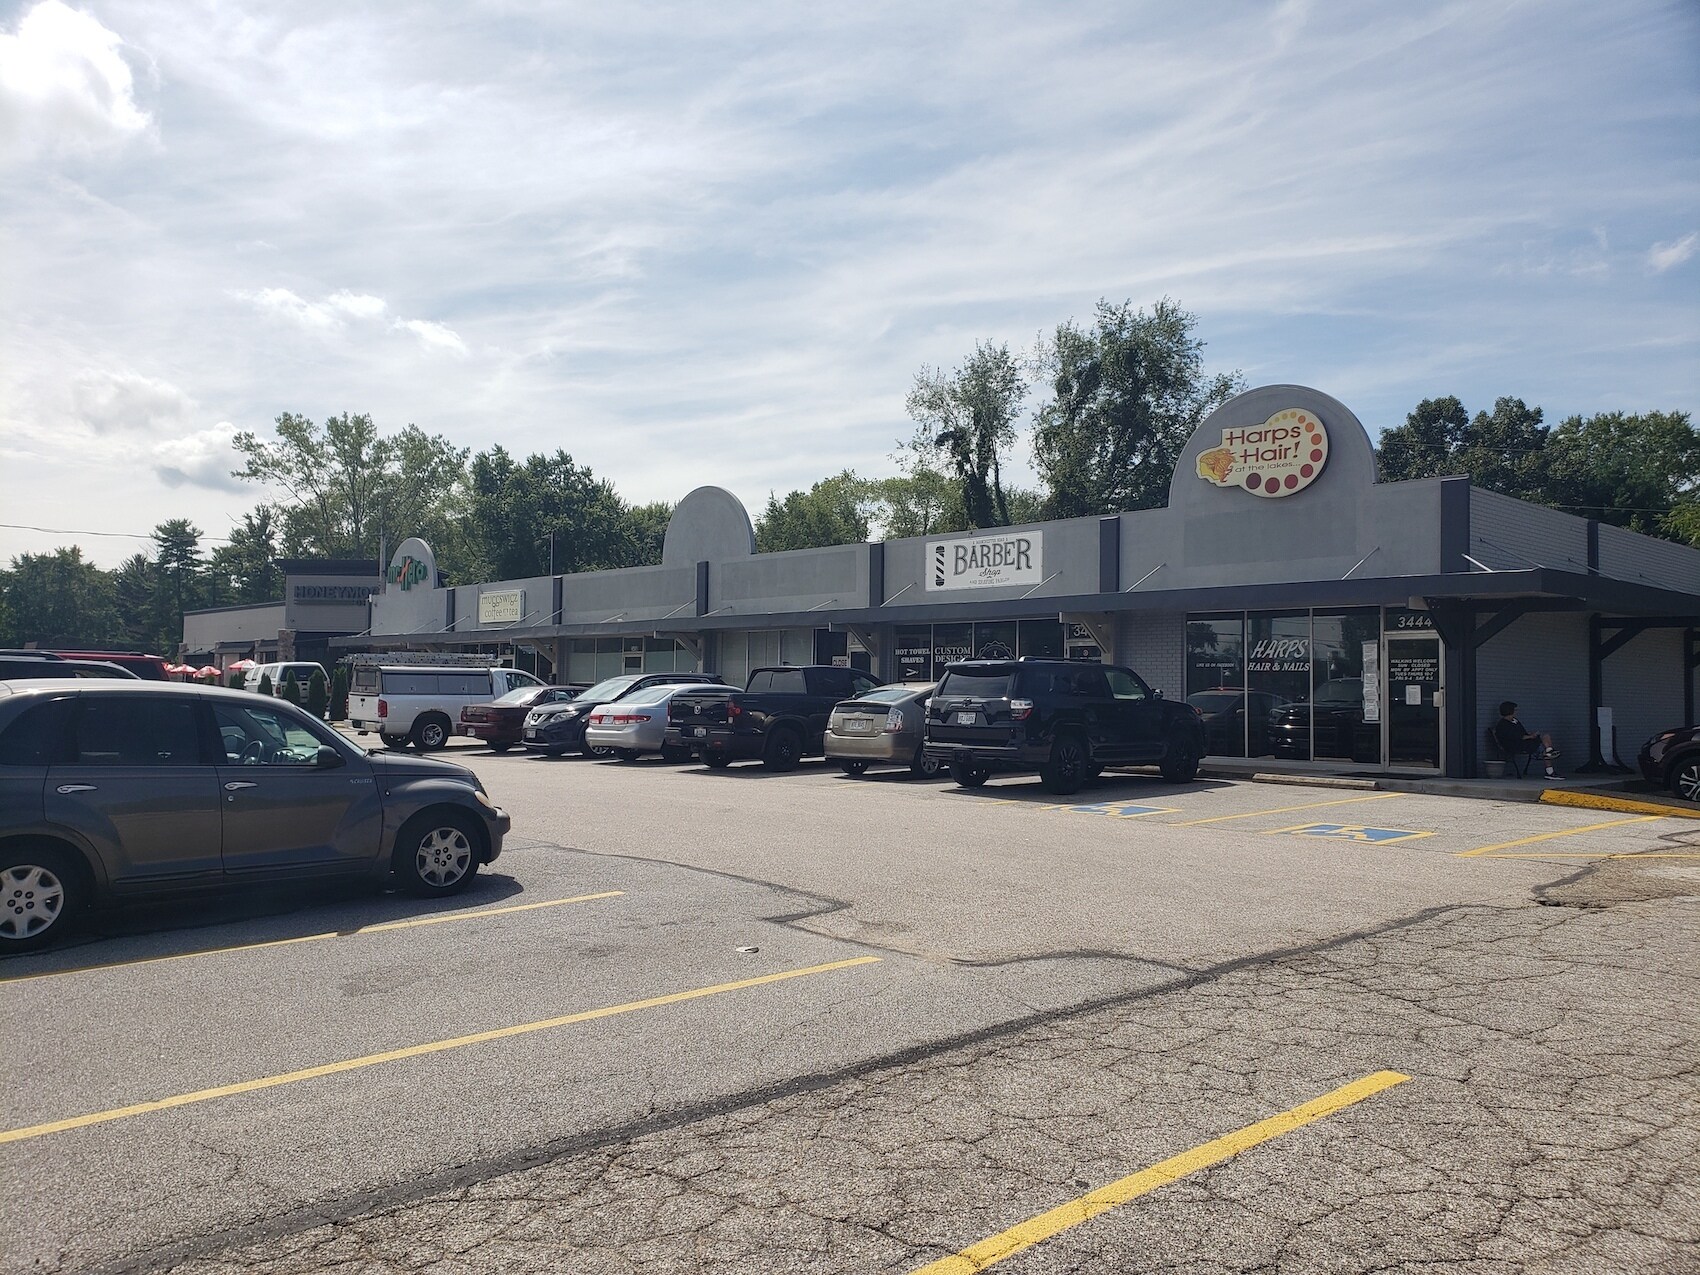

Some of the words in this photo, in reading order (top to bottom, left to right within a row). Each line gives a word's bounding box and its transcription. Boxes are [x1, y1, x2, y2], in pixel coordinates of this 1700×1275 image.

[1226, 426, 1300, 446] Harps
[1239, 441, 1301, 464] Hair!
[1247, 464, 1265, 472] the
[953, 538, 1033, 576] BARBER
[979, 568, 1001, 577] Shop
[481, 594, 519, 608] muggswigz
[1398, 616, 1432, 627] 3444
[909, 647, 931, 655] TOWEL
[934, 646, 972, 655] CUSTOM
[1251, 640, 1308, 658] HARPS
[1247, 662, 1271, 671] HAIR
[1272, 662, 1281, 671] &
[1281, 662, 1311, 671] NAILS
